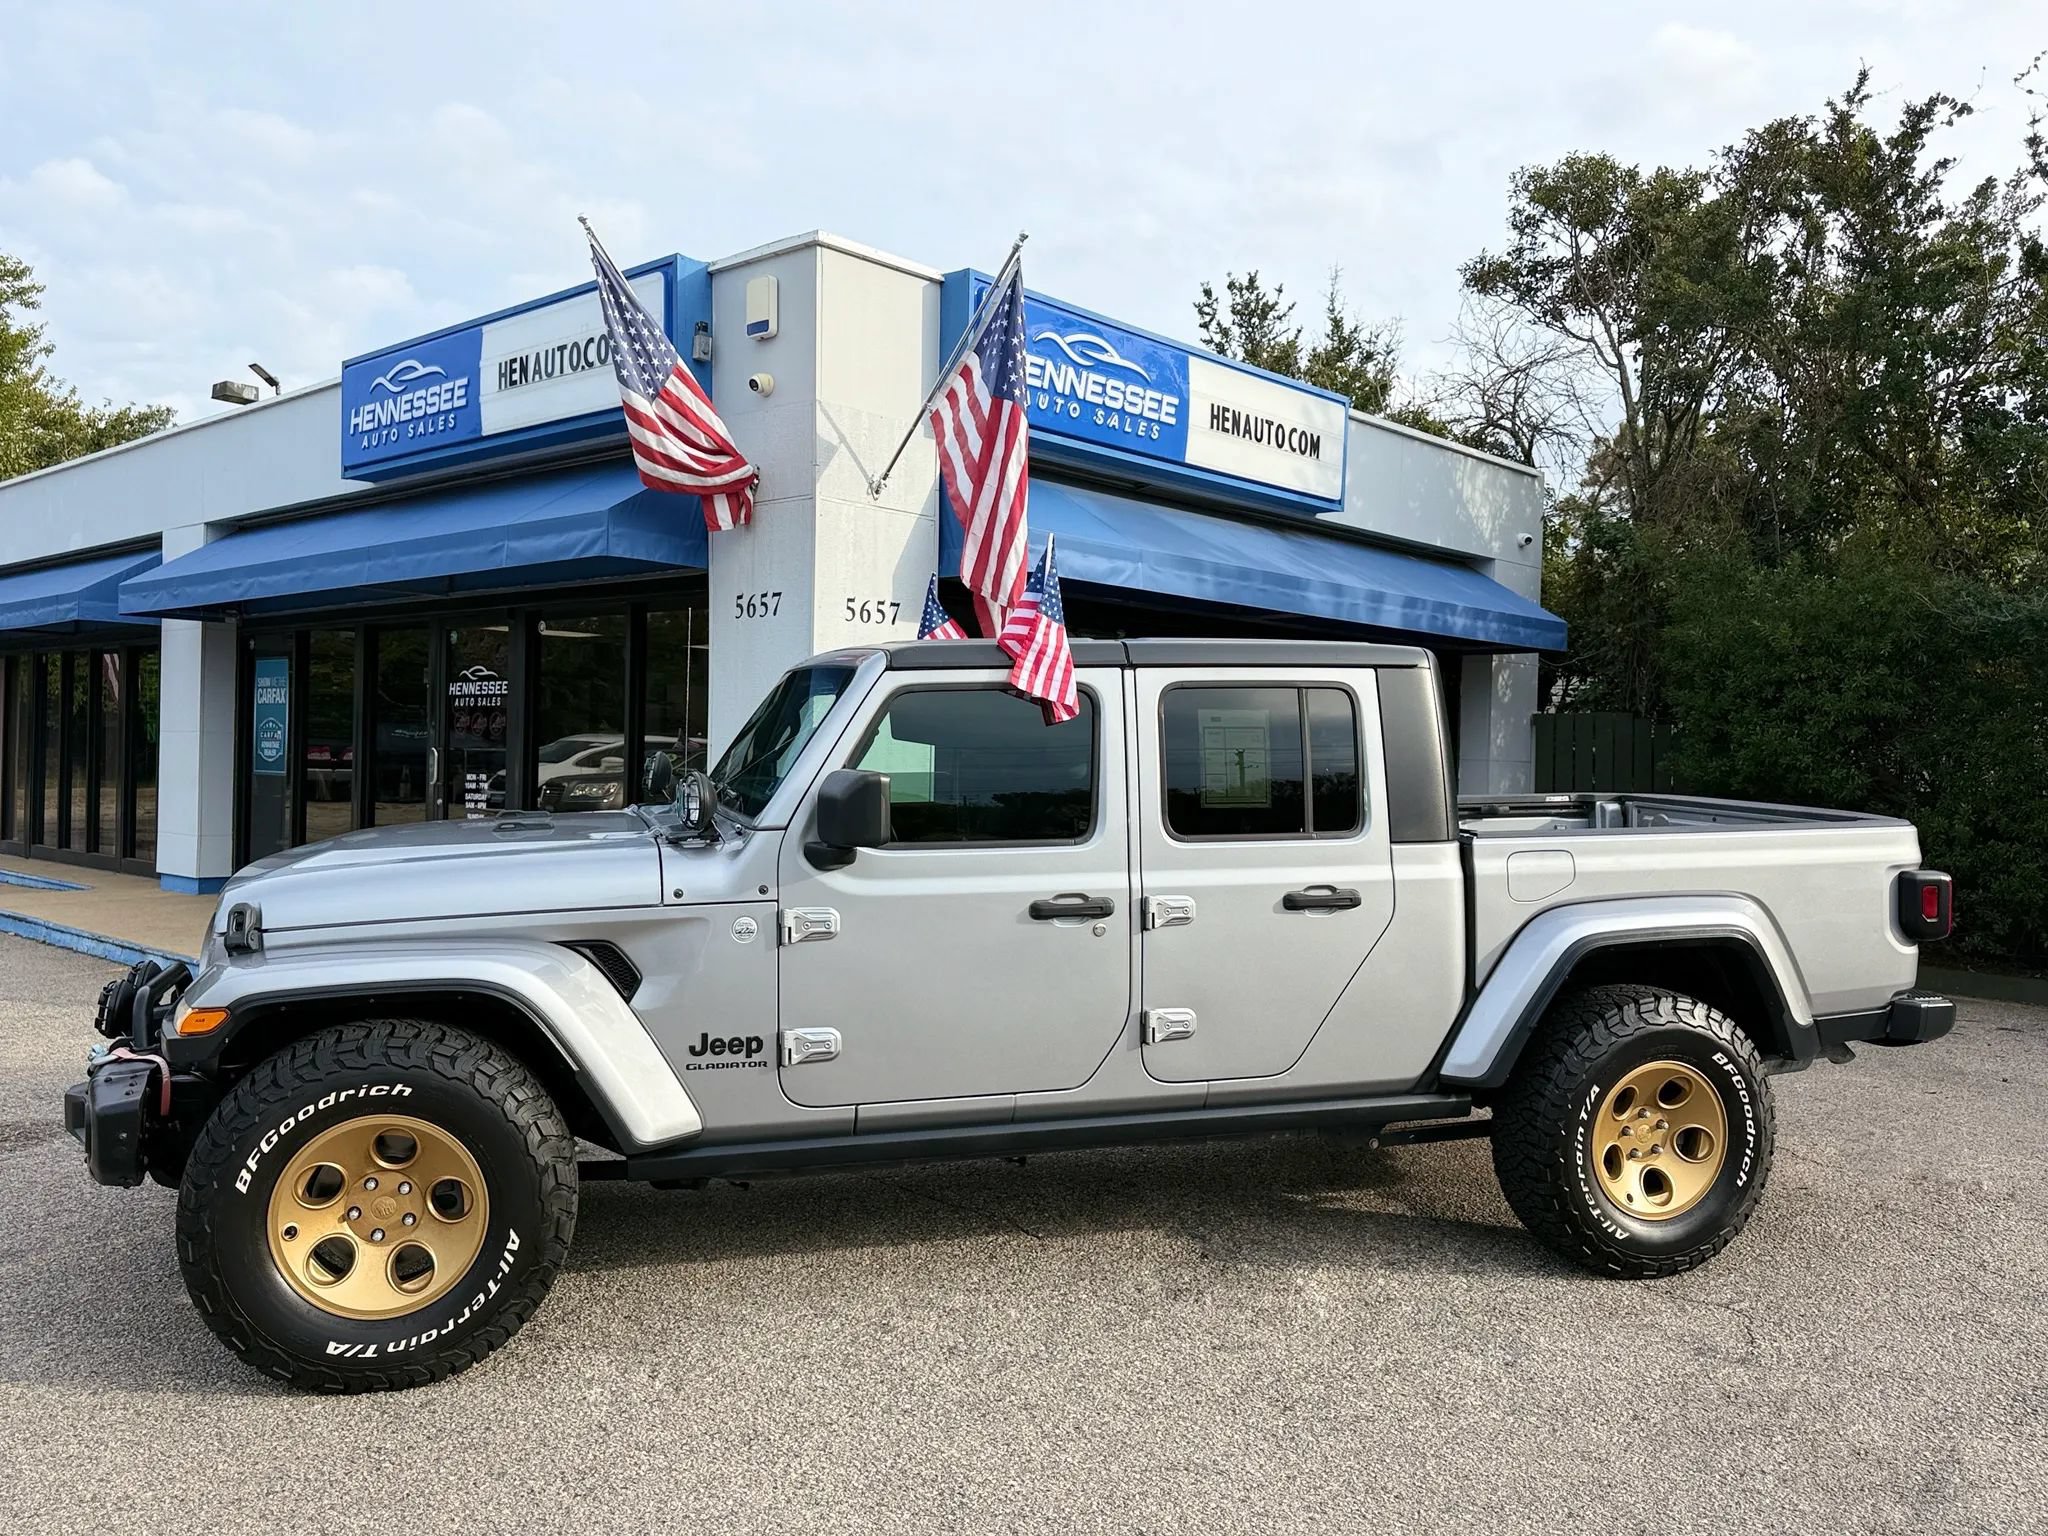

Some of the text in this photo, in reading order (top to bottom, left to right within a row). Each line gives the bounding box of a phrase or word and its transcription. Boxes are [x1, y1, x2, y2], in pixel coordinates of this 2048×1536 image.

[498, 333, 609, 391] HENAUTO.CO
[350, 377, 468, 435] HENNESSEE
[1026, 354, 1179, 425] ENNESSEE
[362, 413, 455, 449] AUTO SALES
[1094, 408, 1160, 440] SALES
[735, 591, 782, 619] 5657
[845, 596, 900, 626] 5657
[257, 687, 286, 704] CARFAX
[449, 681, 509, 695] HENNESSEE
[454, 697, 501, 707] AUTO SALES
[688, 1032, 764, 1058] Jeep
[686, 1061, 767, 1070] GLADIATOR
[1711, 1051, 1756, 1187] BFGoodrich
[235, 1083, 413, 1194] BFGoodrich
[1574, 1084, 1630, 1240] All-Terrain T/A
[325, 1228, 521, 1358] All-Terrain T/A
